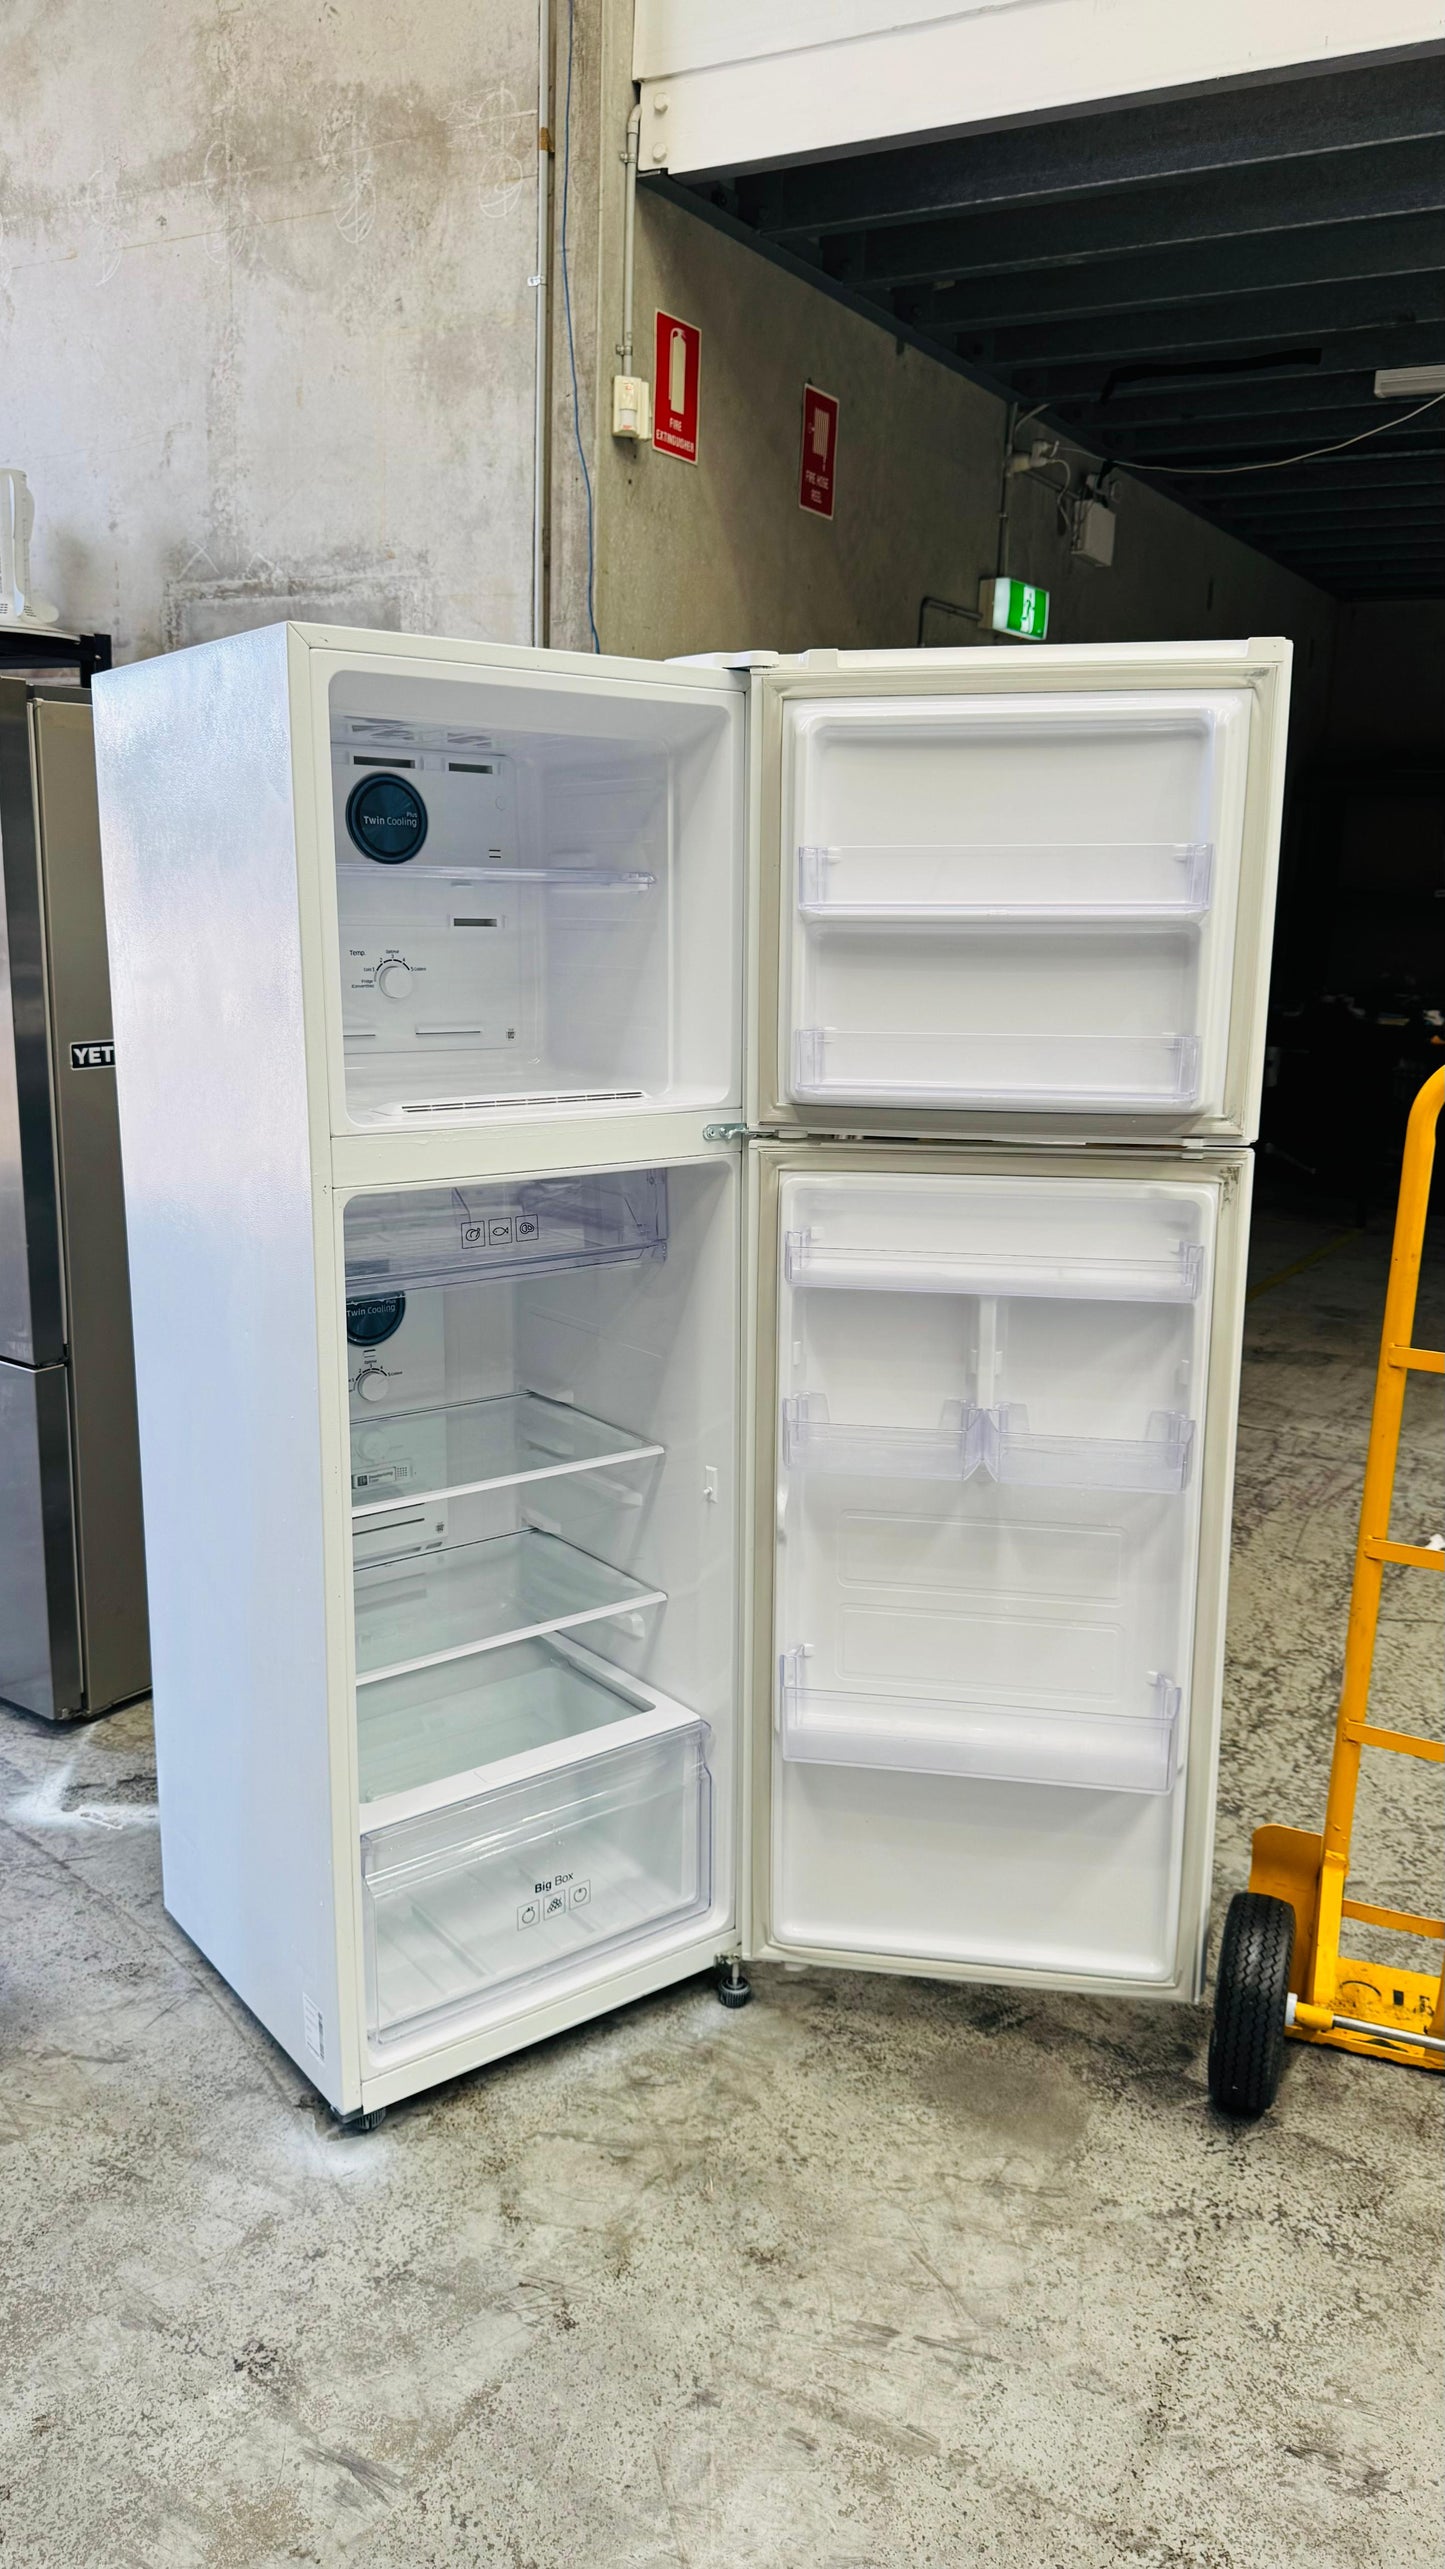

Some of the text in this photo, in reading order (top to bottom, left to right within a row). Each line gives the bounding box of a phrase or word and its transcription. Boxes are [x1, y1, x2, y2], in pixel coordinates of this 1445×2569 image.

[669, 417, 682, 432] FIRE
[656, 428, 694, 453] EXTINGUISHER
[805, 470, 816, 485] FIRE
[364, 816, 417, 828] Twin Cooling
[368, 1304, 396, 1314] Cooling
[535, 1872, 574, 1893] Big Box
